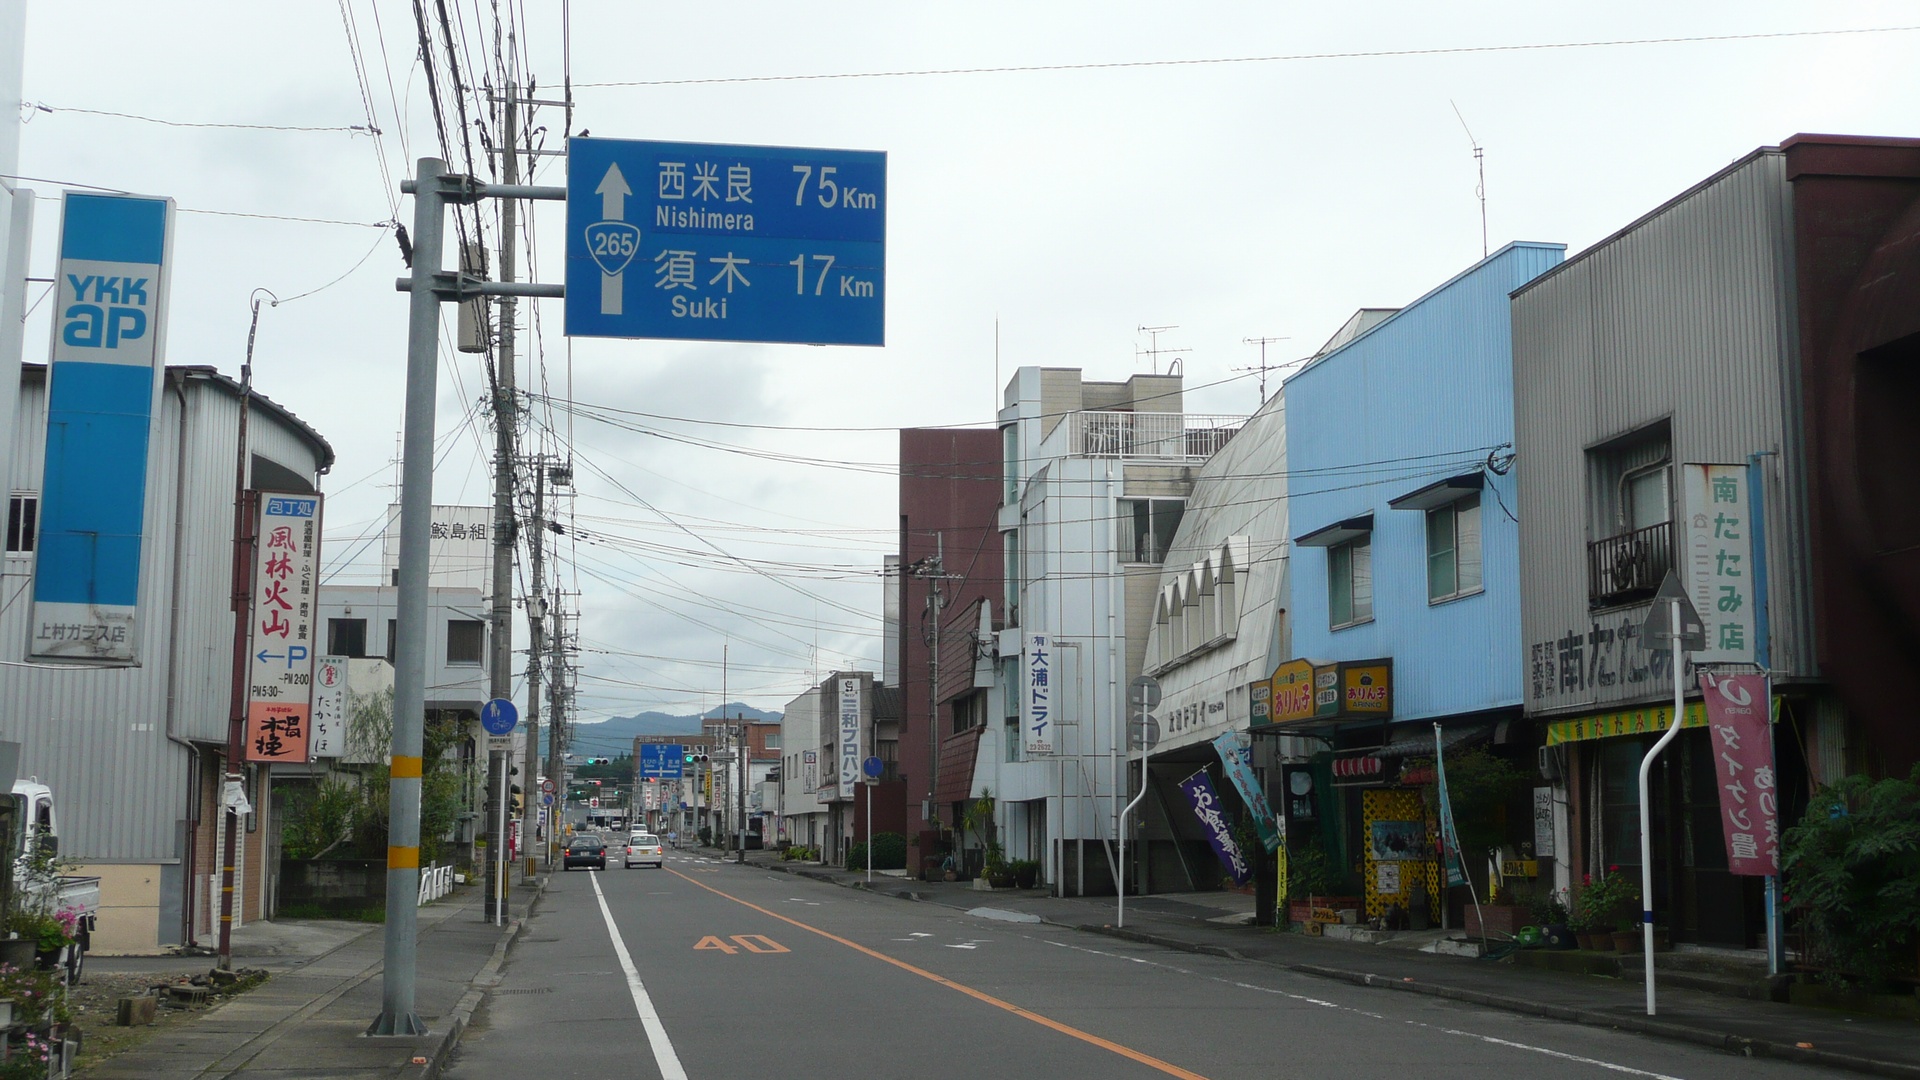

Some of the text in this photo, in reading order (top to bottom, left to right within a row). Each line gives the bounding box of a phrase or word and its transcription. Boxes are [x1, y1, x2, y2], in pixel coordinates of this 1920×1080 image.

[658, 161, 876, 210] 西米良 75 Km
[656, 205, 754, 231] Nishimera
[595, 232, 634, 257] 265
[654, 249, 874, 298] 須木 17 Km
[67, 273, 148, 307] YKK
[671, 294, 728, 319] Suki
[62, 304, 148, 349] ap
[269, 500, 312, 516] 包丁処
[430, 522, 487, 541] 鮫島組
[1711, 475, 1745, 651] 南たたみ店
[262, 526, 296, 639] 風林火山
[37, 622, 126, 643] 上村ガラス店
[288, 646, 307, 669] P
[1031, 648, 1049, 737] 大浦ドライ
[1275, 684, 1311, 715] ありん子
[1347, 686, 1387, 700] ありん子
[1575, 710, 1666, 738] 南たたみ店
[841, 699, 859, 785] 三和プロパン
[1193, 785, 1248, 879] お食事処
[692, 934, 792, 955] 40
